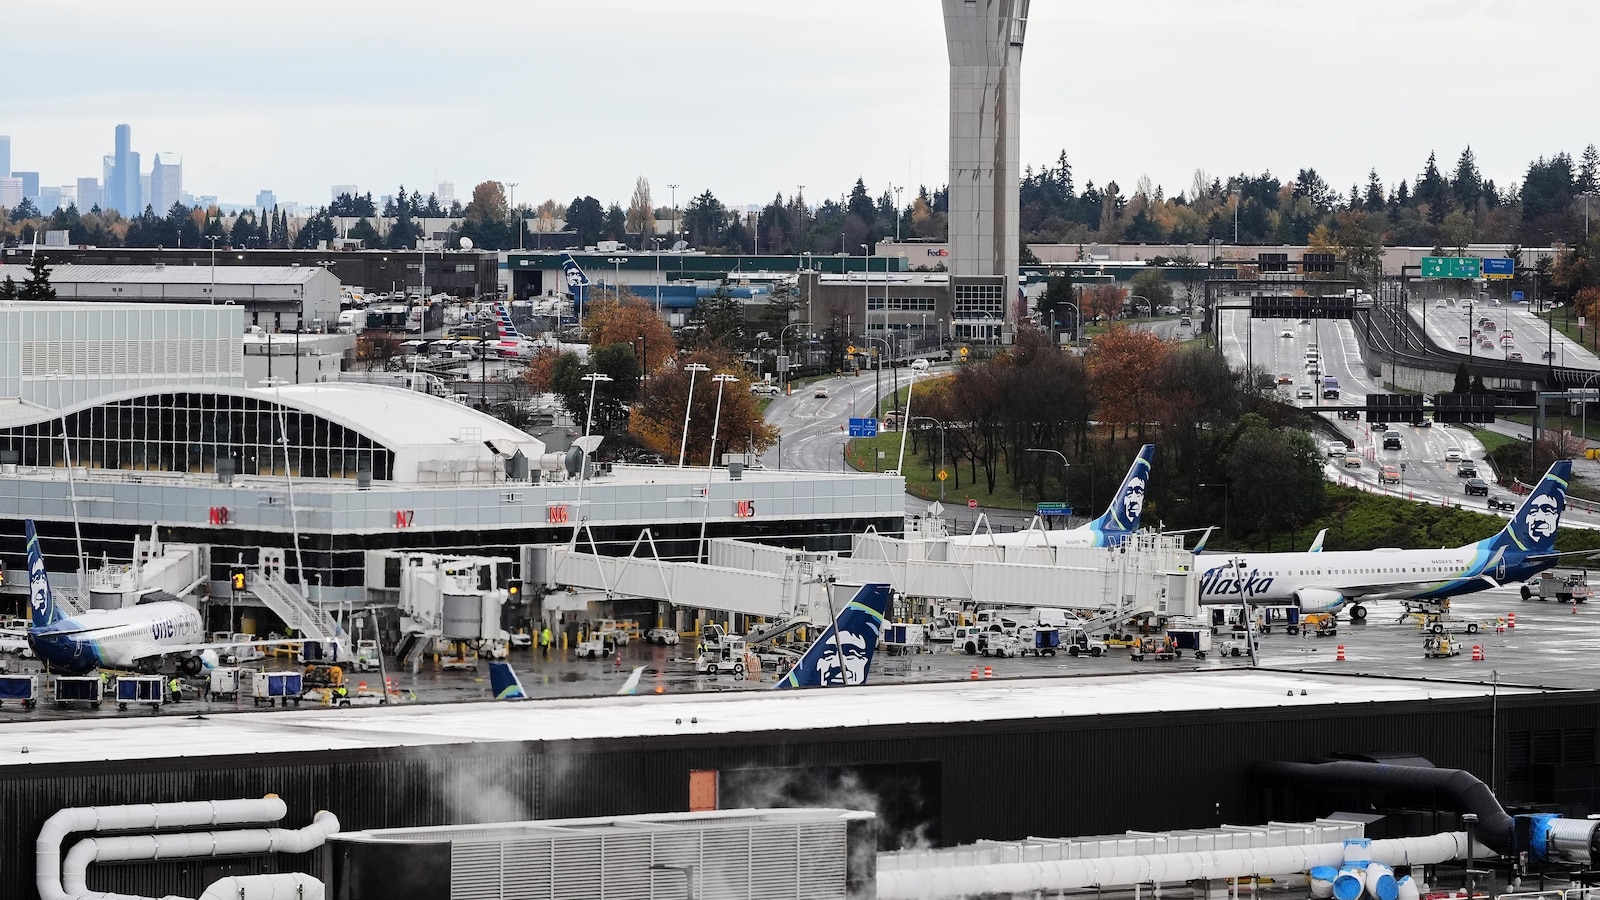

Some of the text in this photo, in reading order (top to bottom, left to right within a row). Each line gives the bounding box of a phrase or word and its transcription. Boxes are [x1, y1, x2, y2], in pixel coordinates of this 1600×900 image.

[209, 506, 228, 525] N8
[549, 505, 569, 523] N6
[737, 500, 755, 518] N5
[396, 510, 414, 528] N7
